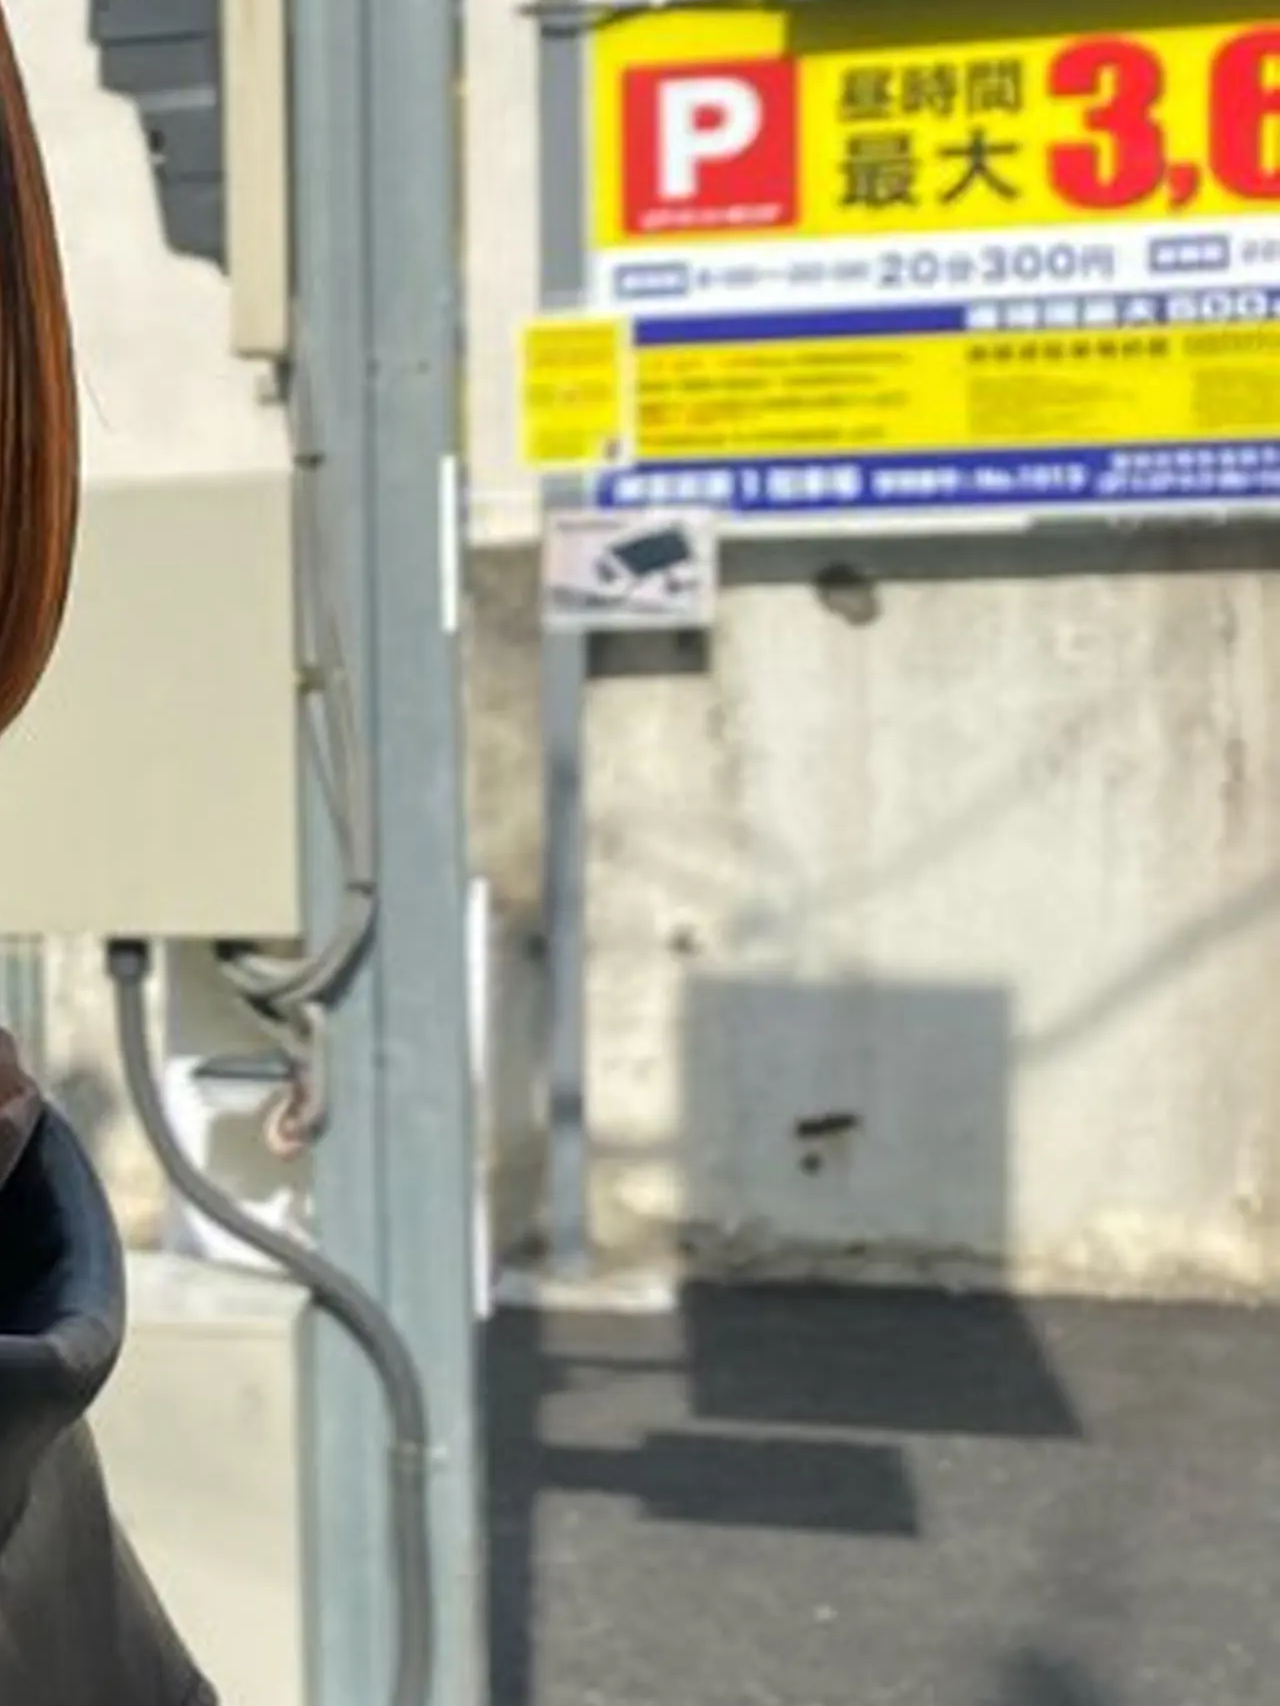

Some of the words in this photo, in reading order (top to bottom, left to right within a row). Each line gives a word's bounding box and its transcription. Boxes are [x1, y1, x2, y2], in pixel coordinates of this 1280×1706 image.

[840, 59, 1023, 121] 昼時間
[659, 77, 763, 200] P
[838, 127, 1021, 209] 最大
